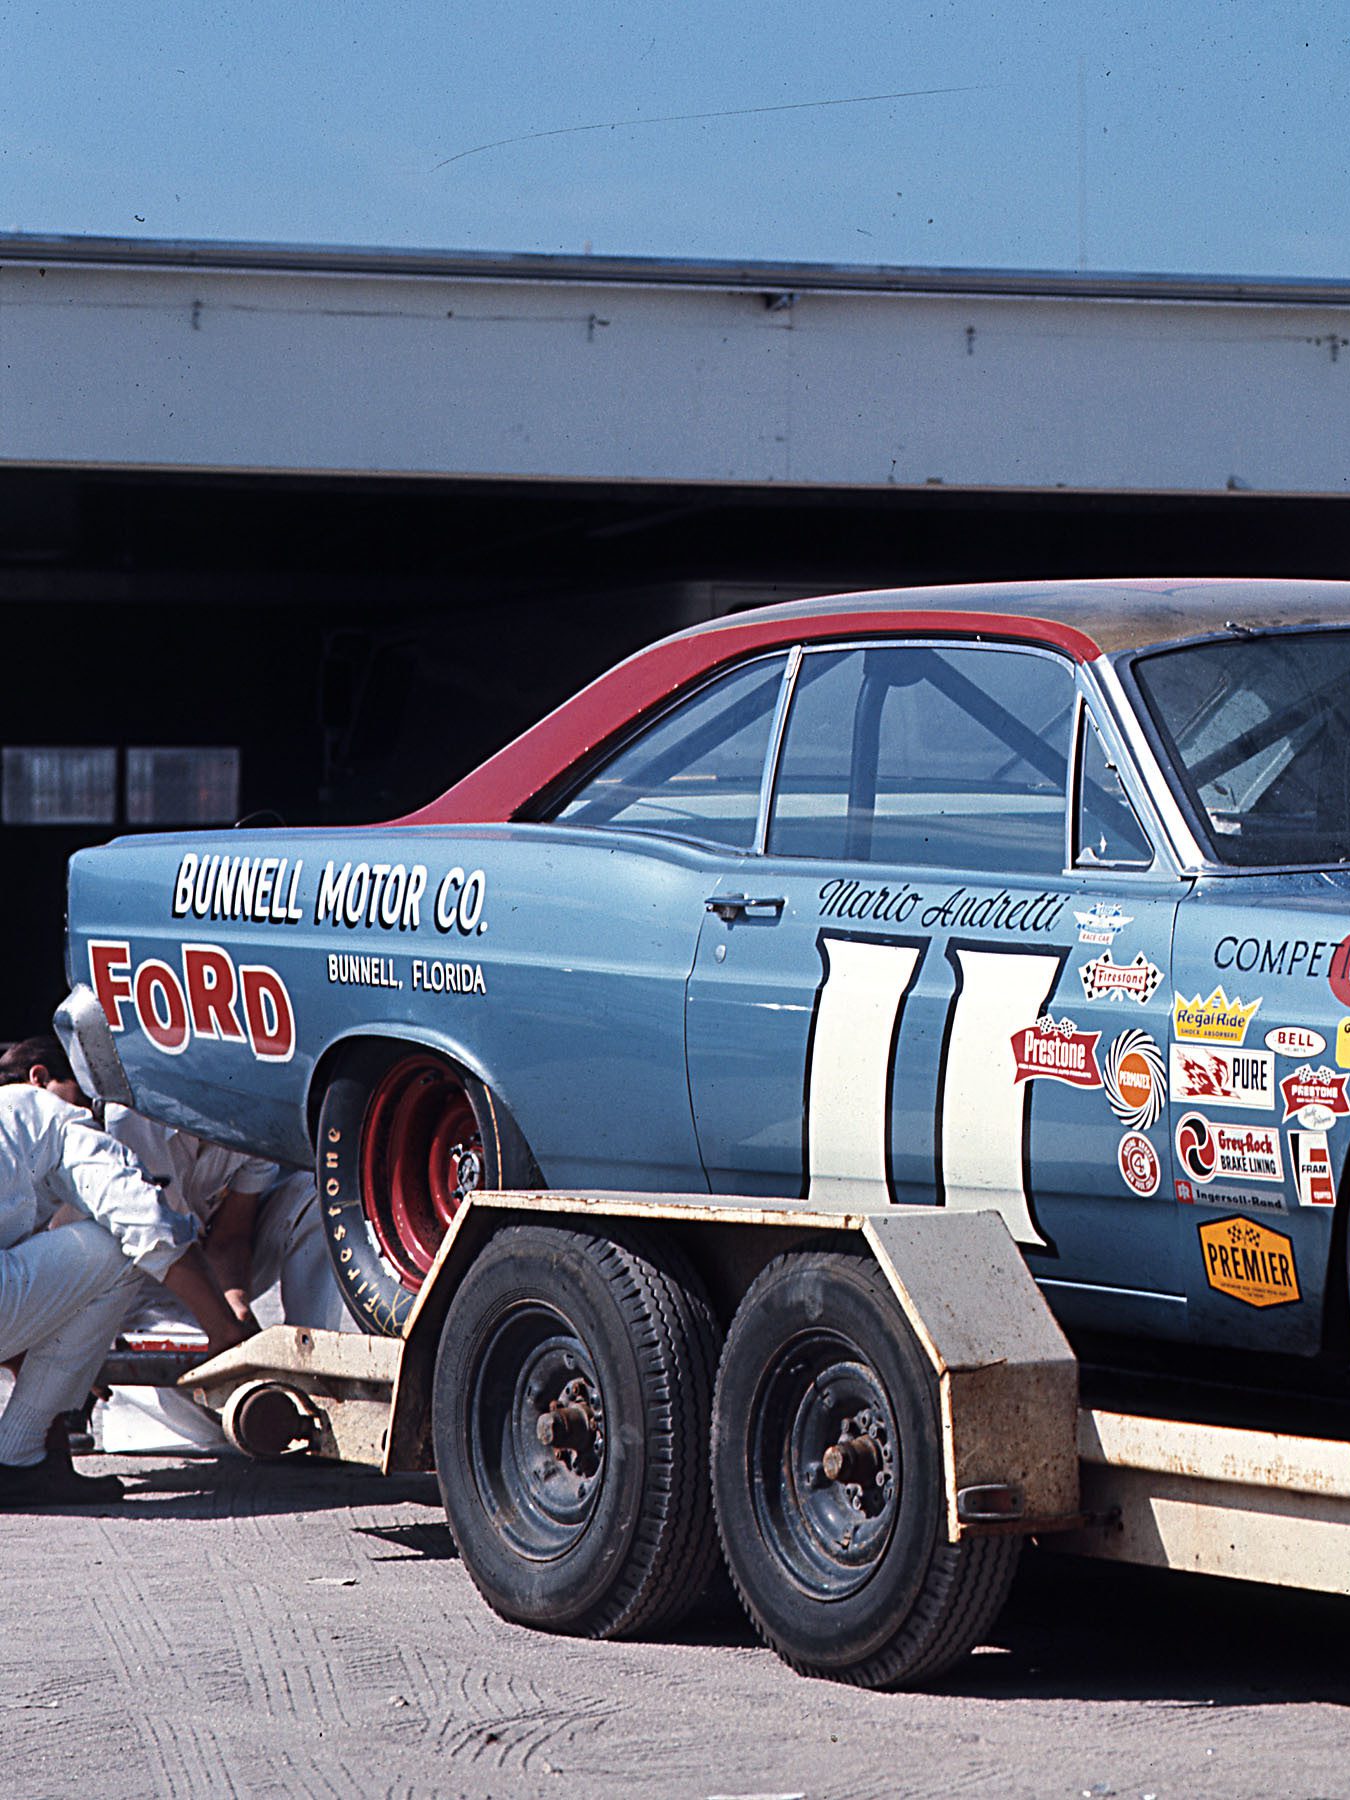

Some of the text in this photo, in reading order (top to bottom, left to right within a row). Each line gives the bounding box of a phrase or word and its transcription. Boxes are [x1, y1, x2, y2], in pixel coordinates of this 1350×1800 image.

[172, 852, 489, 935] BUNNELL MOTOR CO.
[818, 878, 1071, 932] Mario Andretti
[327, 954, 487, 995] BUNNELL, FLORIDA
[1098, 968, 1144, 984] Firestone
[87, 939, 296, 1062] FORD
[1024, 1030, 1086, 1070] Prestone
[1277, 1031, 1314, 1047] BELL
[1119, 1070, 1151, 1090] PERMATEX
[1232, 1057, 1267, 1091] PURE
[802, 928, 1073, 1258] 11
[1291, 1084, 1338, 1099] PRESTONE
[1218, 1129, 1273, 1155] Grey-Rock
[1220, 1155, 1276, 1175] BRAKE LINING
[1301, 1164, 1327, 1174] FRAM
[1196, 1189, 1282, 1208] Ingersoll-Rand
[326, 1127, 380, 1314] Firestone
[1207, 1242, 1293, 1287] PREMIER
